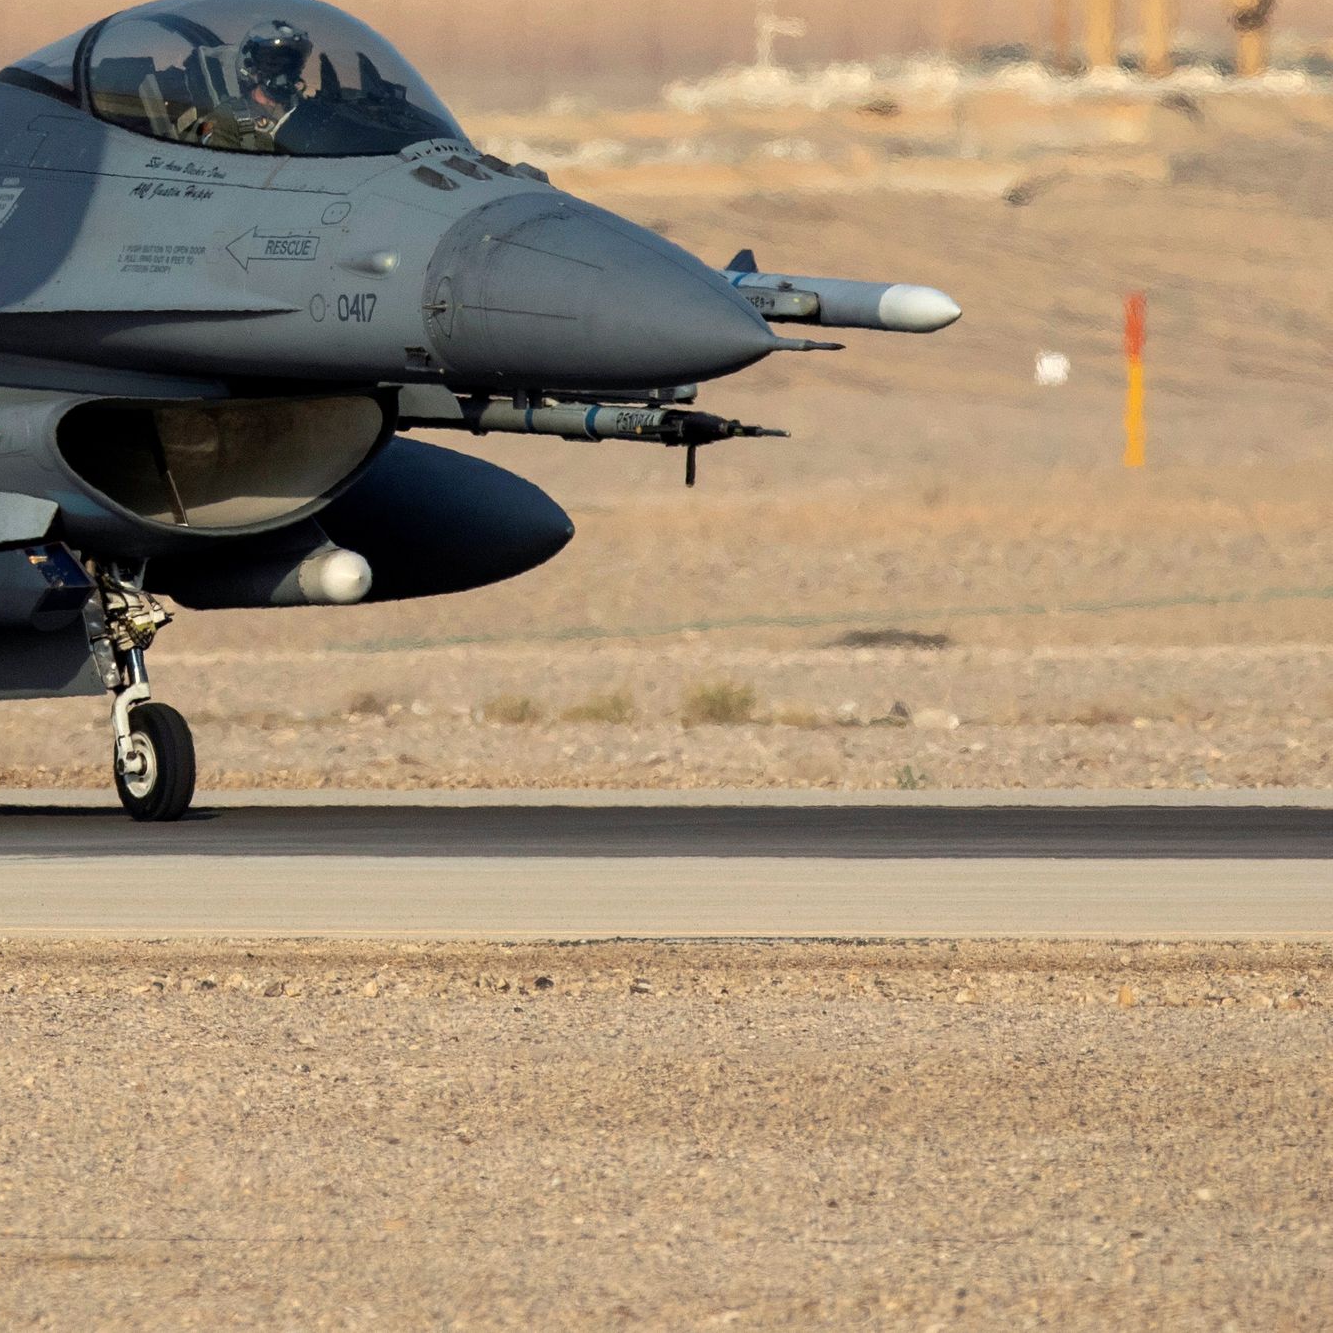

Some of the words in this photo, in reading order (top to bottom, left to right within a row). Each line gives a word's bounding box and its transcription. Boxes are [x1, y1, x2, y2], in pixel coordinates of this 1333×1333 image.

[165, 245, 173, 254] TO
[265, 240, 312, 256] RESCUE
[338, 293, 377, 322] 0417
